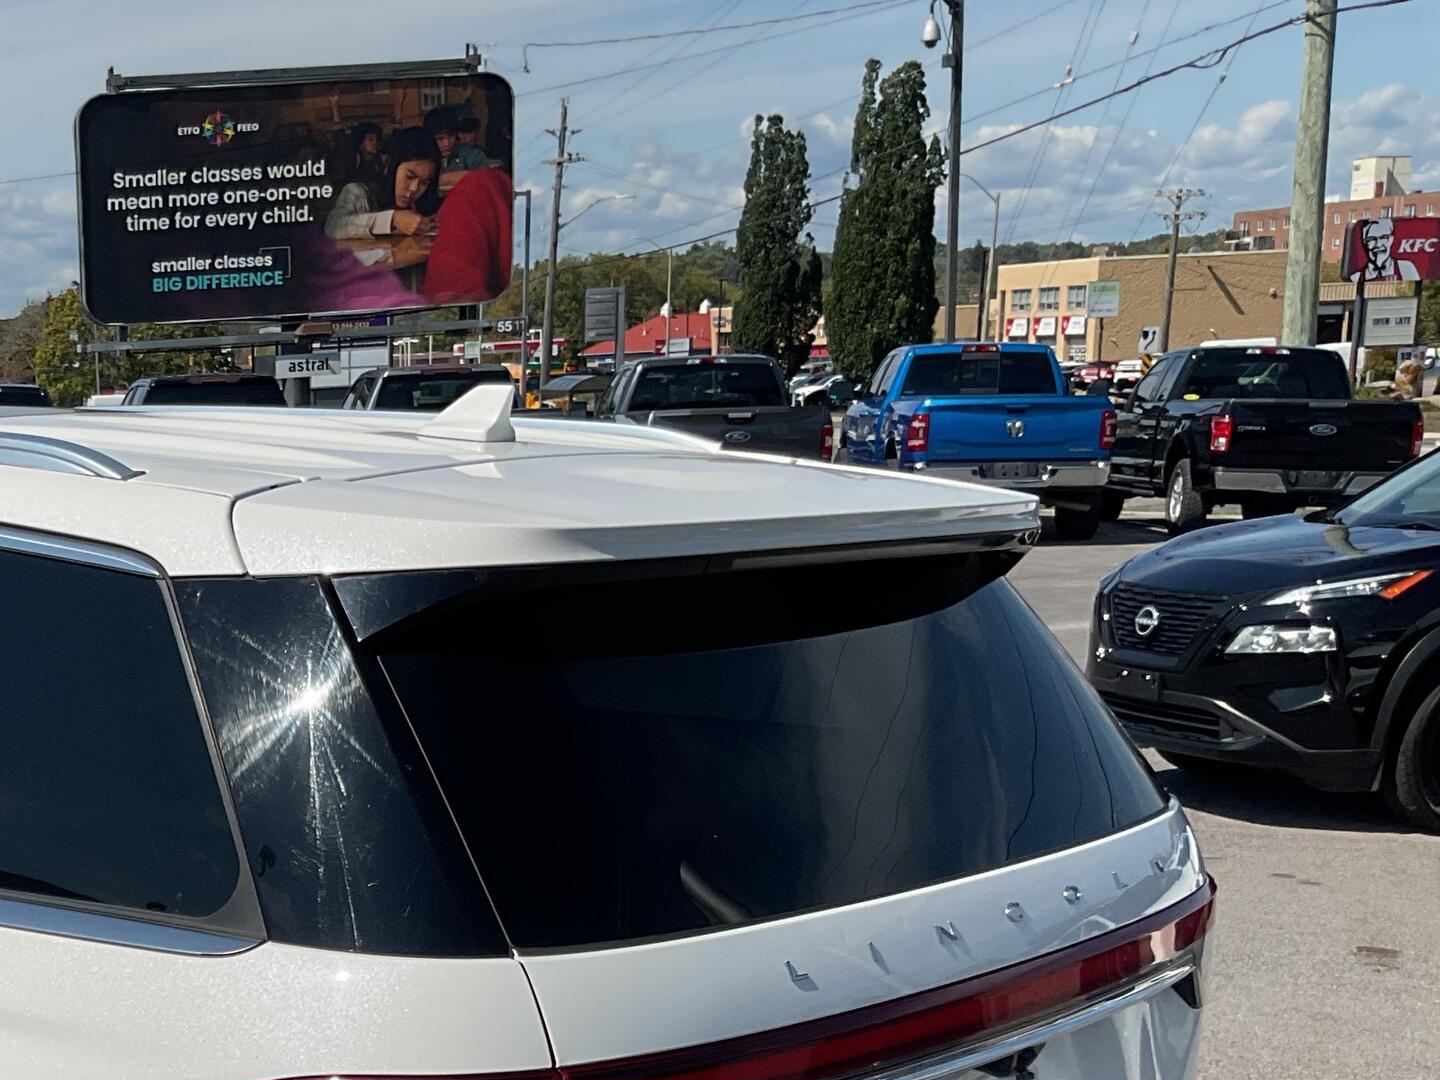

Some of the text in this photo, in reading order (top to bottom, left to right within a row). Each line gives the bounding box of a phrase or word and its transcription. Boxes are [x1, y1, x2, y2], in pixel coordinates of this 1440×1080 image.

[178, 123, 259, 135] ETFO FEEO
[113, 160, 325, 188] Smaller classes would
[107, 185, 333, 211] mean more one-on-one
[126, 205, 314, 231] time for every child.
[1398, 238, 1439, 252] KFC
[152, 255, 273, 273] smaller classes
[153, 271, 283, 292] BIG DIFFERENCE
[288, 357, 329, 372] astral
[783, 856, 1166, 982] LINCOLN
